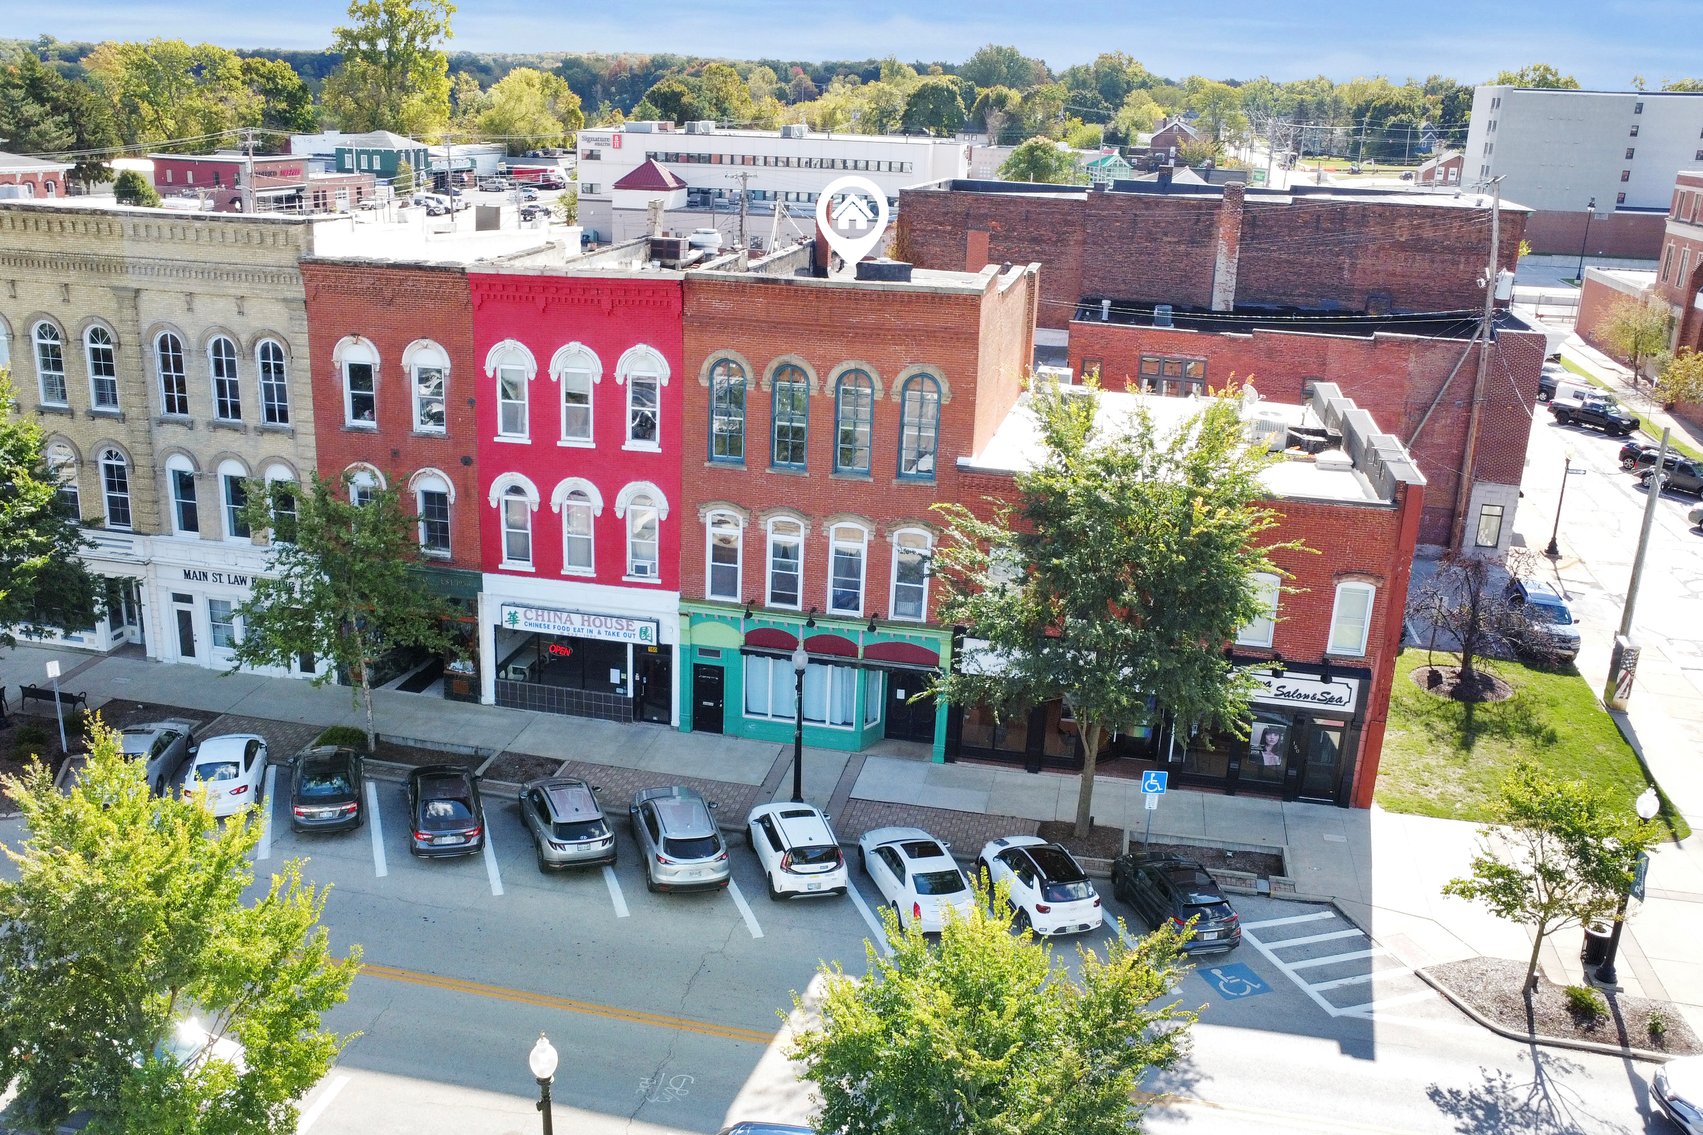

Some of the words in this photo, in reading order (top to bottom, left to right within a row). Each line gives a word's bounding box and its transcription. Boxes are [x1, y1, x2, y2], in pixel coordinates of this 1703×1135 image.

[581, 135, 611, 143] Signature
[183, 569, 209, 582] MAIN
[228, 574, 248, 587] LAW
[523, 608, 575, 626] CHINA
[581, 614, 636, 632] HOUSE
[524, 621, 551, 630] CHINESE
[552, 623, 571, 632] FOOD
[604, 630, 620, 638] TAKE
[623, 631, 636, 639] OUT
[549, 643, 571, 656] OPEN
